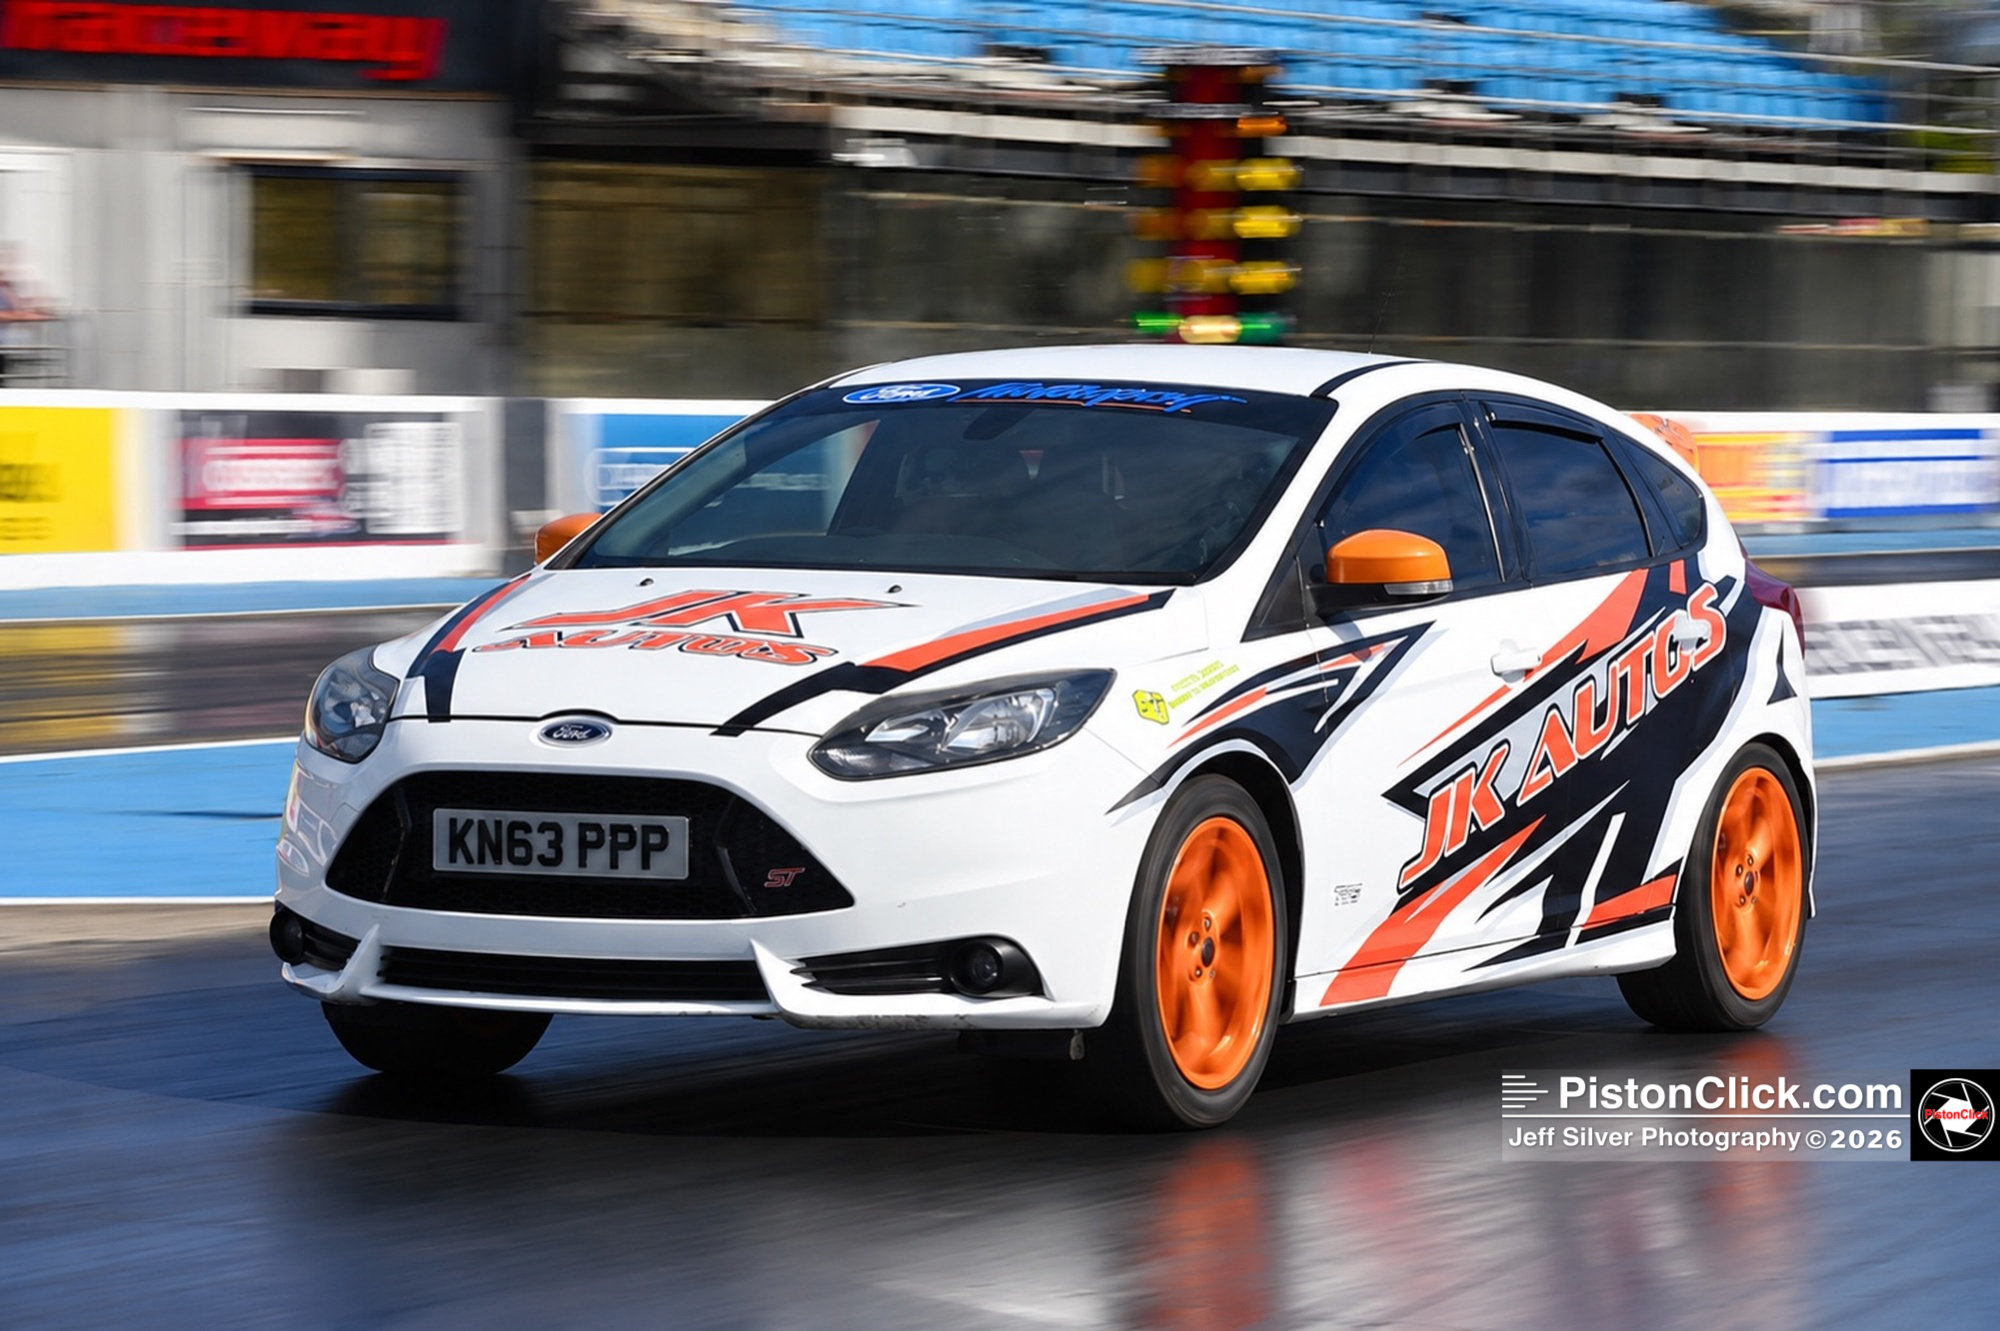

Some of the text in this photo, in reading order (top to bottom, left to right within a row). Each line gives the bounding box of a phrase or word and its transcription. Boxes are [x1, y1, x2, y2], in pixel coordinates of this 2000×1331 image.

[497, 589, 918, 638] JK
[473, 629, 839, 666] AUTOS
[1398, 582, 1728, 890] JK AUTOS
[448, 817, 670, 870] KN63 PPP
[764, 867, 805, 888] ST
